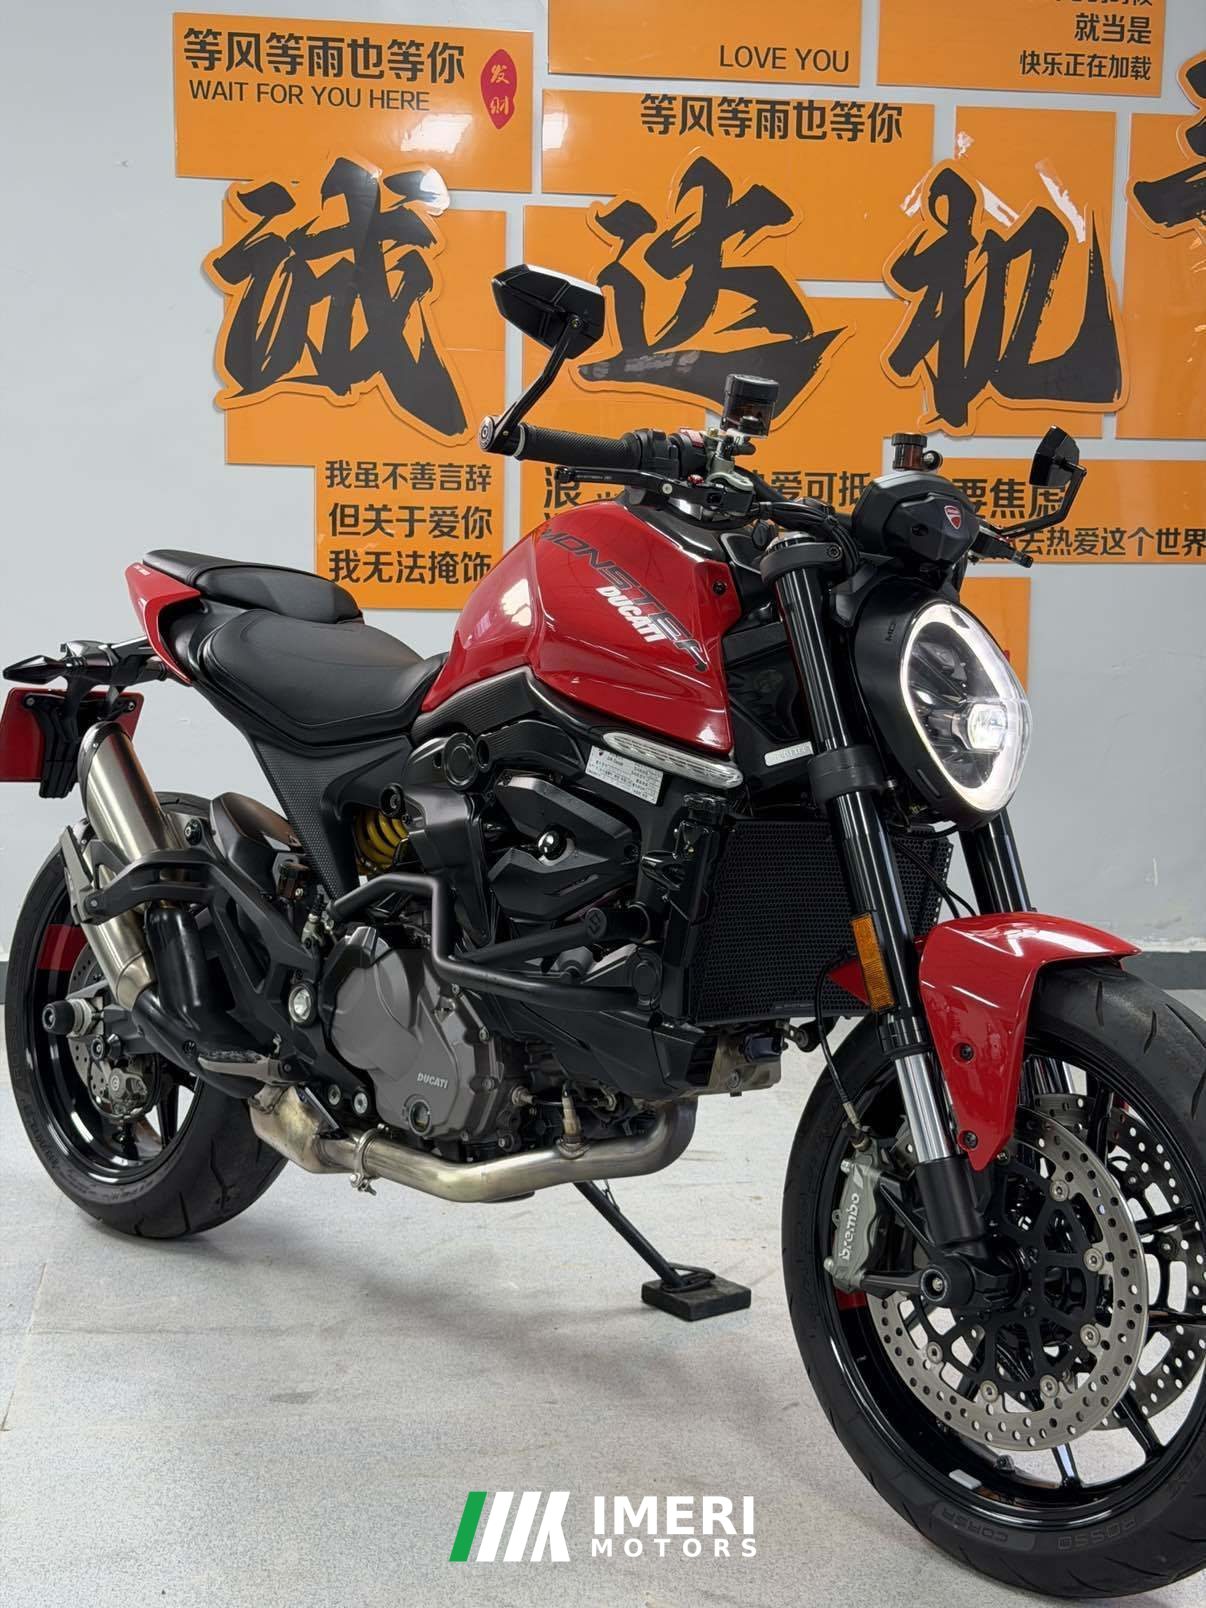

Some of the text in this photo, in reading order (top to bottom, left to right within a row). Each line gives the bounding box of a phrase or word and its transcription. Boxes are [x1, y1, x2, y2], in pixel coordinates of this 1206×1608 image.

[1074, 12, 1152, 45] 就当是
[184, 27, 465, 84] 等风等雨也等你
[719, 45, 850, 74] LOVE YOU
[1019, 49, 1152, 81] 快乐正在加载
[189, 79, 431, 112] WAIT FOR YOU HERE
[640, 93, 903, 143] 等风等雨也等你
[325, 460, 492, 493] 我虽不善言辞
[752, 469, 872, 507] 爱可抵
[328, 503, 493, 540] 但关于爱你
[999, 524, 1206, 558] 去热爱这个世界
[329, 549, 492, 585] 我无法掩饰
[596, 585, 667, 643] DUCATI
[416, 1072, 449, 1089] DUCATI
[839, 1193, 860, 1261] brembo
